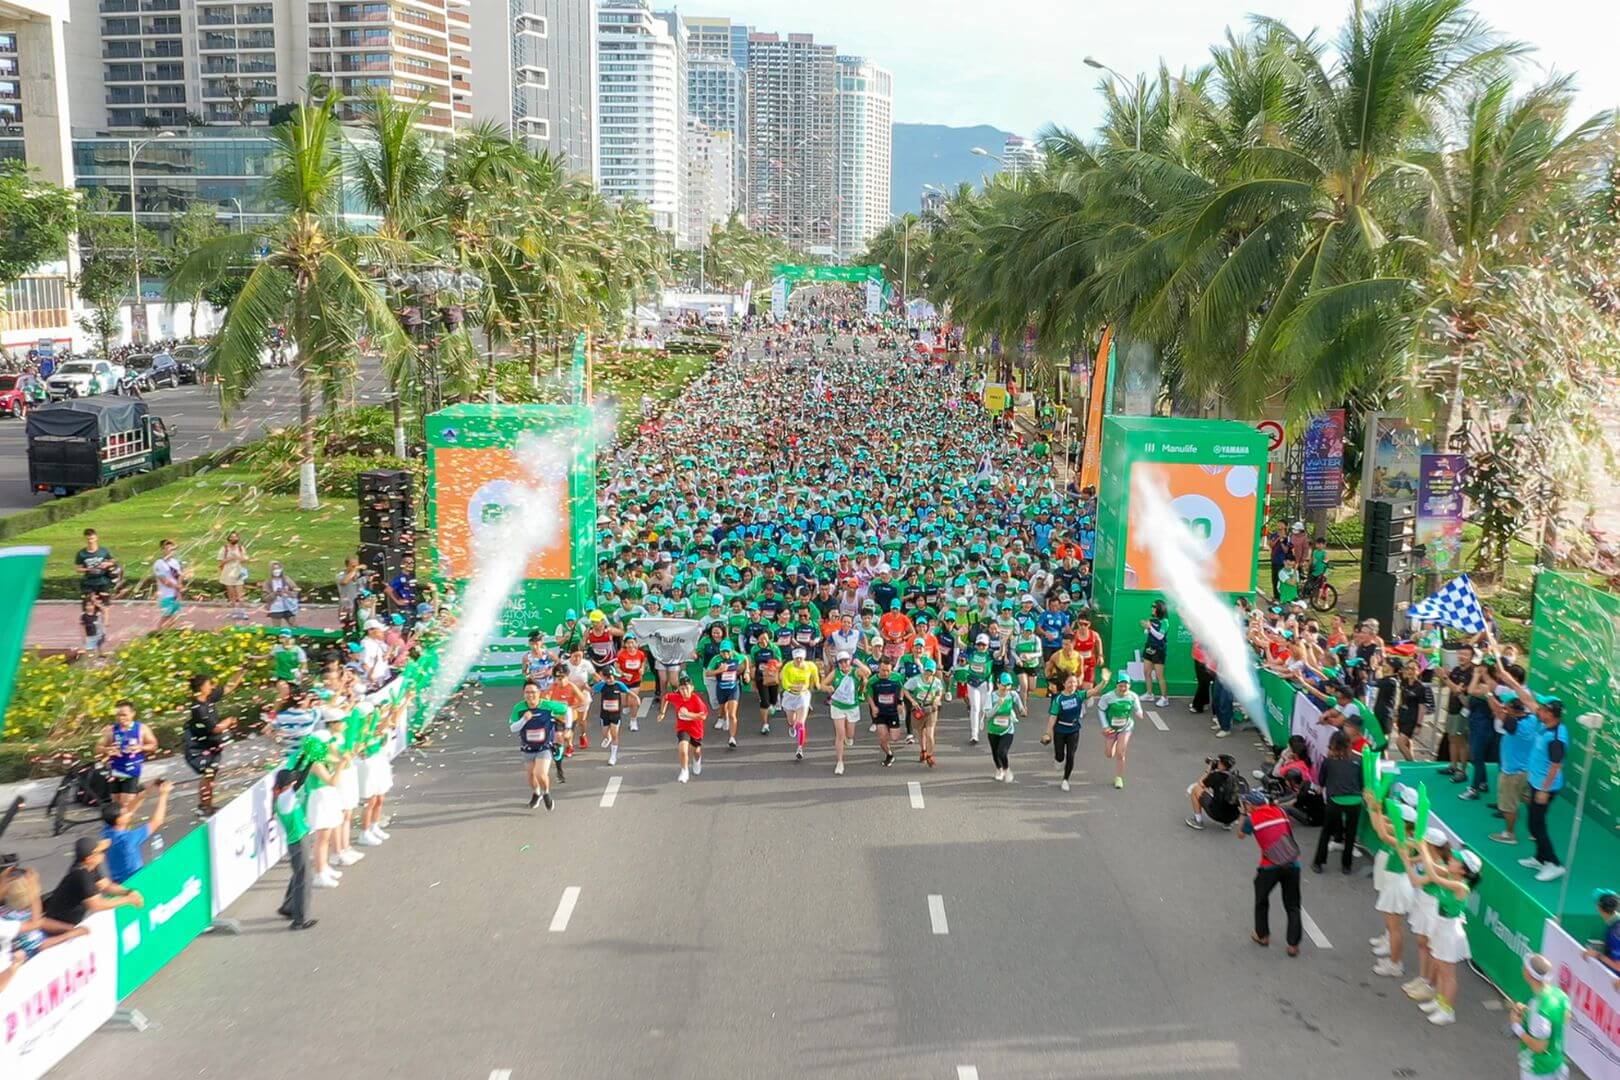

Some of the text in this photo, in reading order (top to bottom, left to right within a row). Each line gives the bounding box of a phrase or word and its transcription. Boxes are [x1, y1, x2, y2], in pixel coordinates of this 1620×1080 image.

[1161, 443, 1198, 454] Manulife
[1222, 446, 1250, 454] YAMAHA
[1307, 458, 1341, 467] WATER
